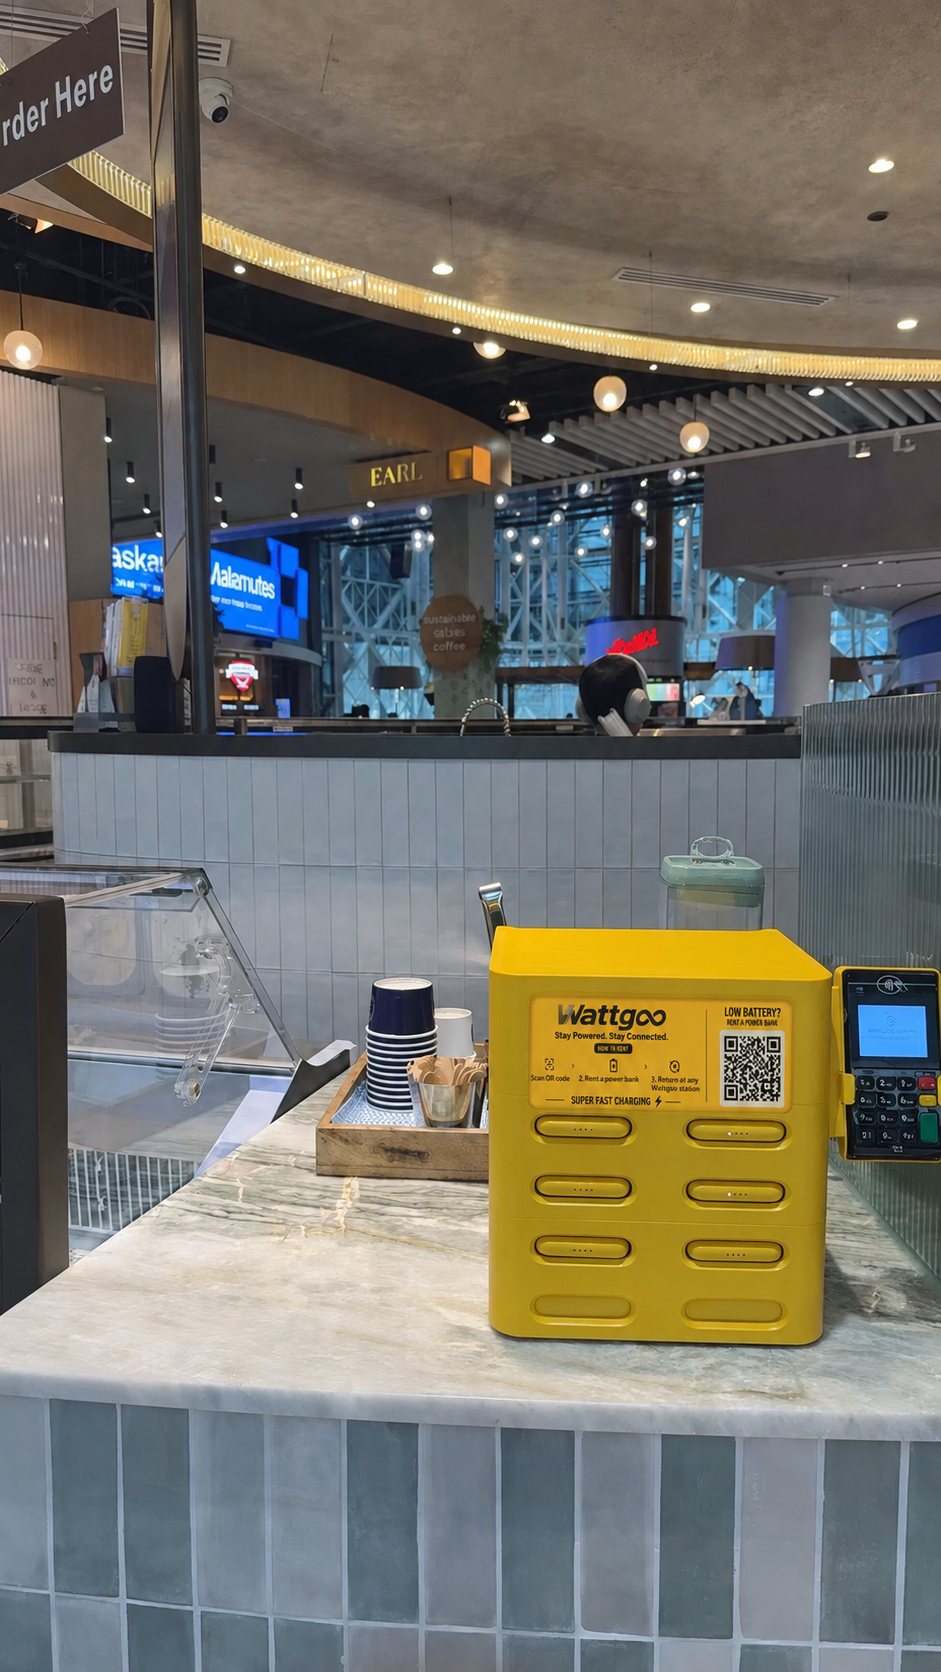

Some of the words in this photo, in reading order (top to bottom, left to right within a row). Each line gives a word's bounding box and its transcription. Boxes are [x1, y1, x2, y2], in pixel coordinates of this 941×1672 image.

[55, 64, 114, 119] Here
[371, 461, 423, 487] EARL
[423, 613, 477, 625] sustainable
[433, 640, 466, 651] coffee
[724, 1007, 742, 1017] LOW
[743, 1007, 782, 1018] BATTERY?
[554, 1031, 572, 1041] Stay
[573, 1032, 608, 1040] Powered.
[609, 1032, 625, 1042] Stay
[626, 1032, 669, 1041] Connected.
[530, 1074, 545, 1082] Scan
[571, 1095, 594, 1105] SUPER
[595, 1096, 613, 1105] FAST
[614, 1096, 651, 1106] CHARGING
